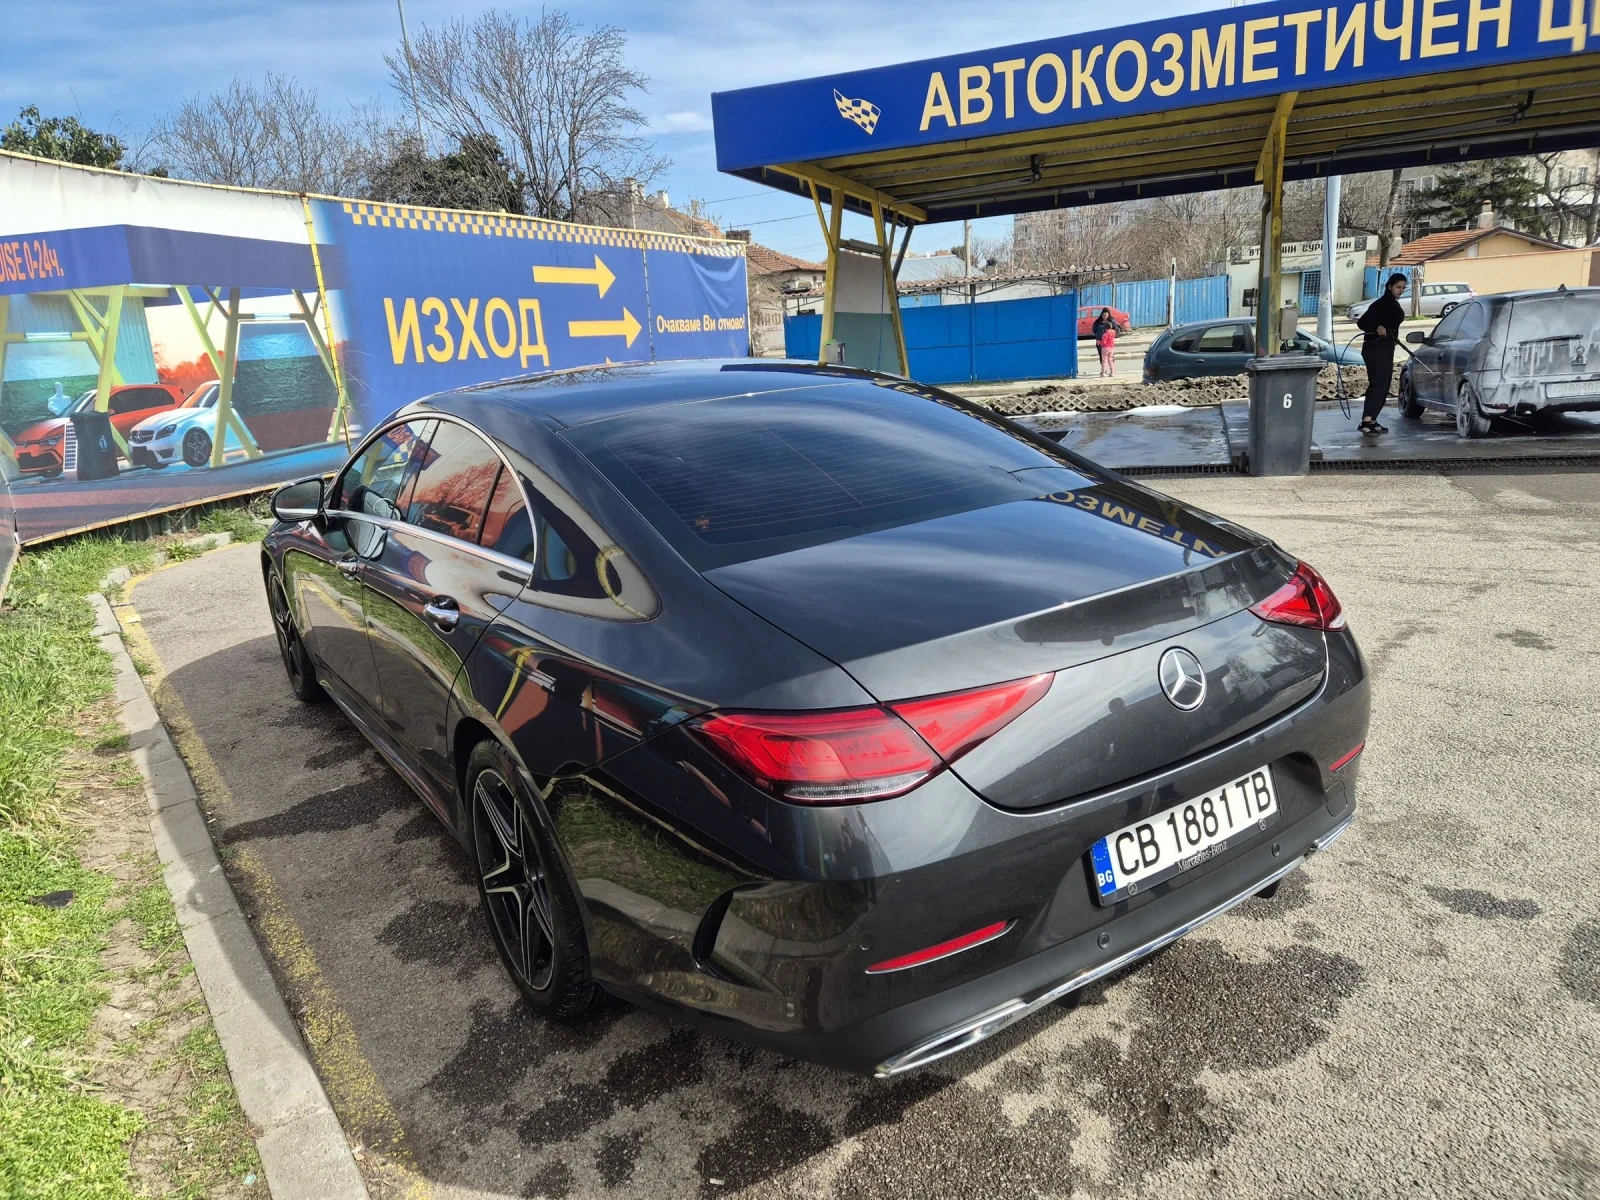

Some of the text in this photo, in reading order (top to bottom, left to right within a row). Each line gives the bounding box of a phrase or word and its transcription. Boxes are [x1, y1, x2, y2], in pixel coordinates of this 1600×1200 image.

[919, 0, 1513, 131] АВТОКОЗМЕТИЧЕН
[383, 297, 550, 368] ИЗХОД
[656, 315, 701, 333] Очакваме
[703, 314, 716, 331] Ви
[718, 313, 746, 331] отново!
[1283, 393, 1293, 409] 6
[1115, 771, 1271, 876] CB 1881 TB
[1176, 841, 1227, 872] Mercedes-Benz
[1098, 869, 1113, 887] BG
